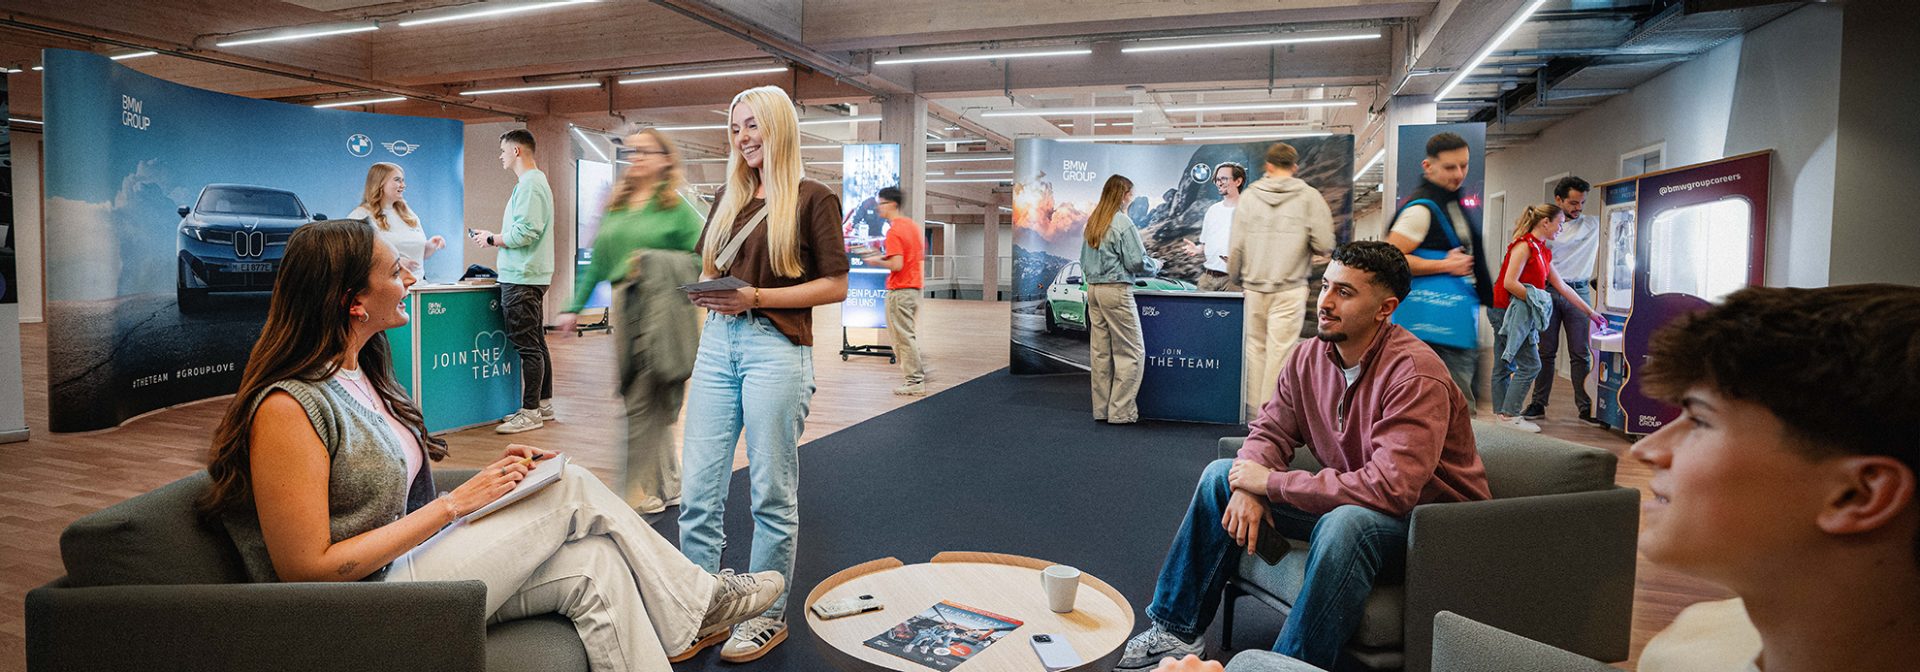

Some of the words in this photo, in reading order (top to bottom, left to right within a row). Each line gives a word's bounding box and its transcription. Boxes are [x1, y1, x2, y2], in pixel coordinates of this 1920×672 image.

[122, 94, 143, 114] BMW
[122, 110, 151, 131] GROUP
[1063, 159, 1088, 171] BMW
[1062, 170, 1097, 182] GROUP
[1658, 173, 1742, 196] @bmwgroupcareers
[847, 288, 863, 298] DEIN
[864, 288, 888, 299] PLATZ
[432, 351, 467, 370] JOIN
[472, 347, 500, 363] THE
[1149, 356, 1173, 367] THE
[1179, 357, 1220, 369] TEAM!
[132, 372, 169, 389] #THETEAM
[176, 362, 235, 379] #GROUPLOVE
[472, 362, 511, 379] TEAM
